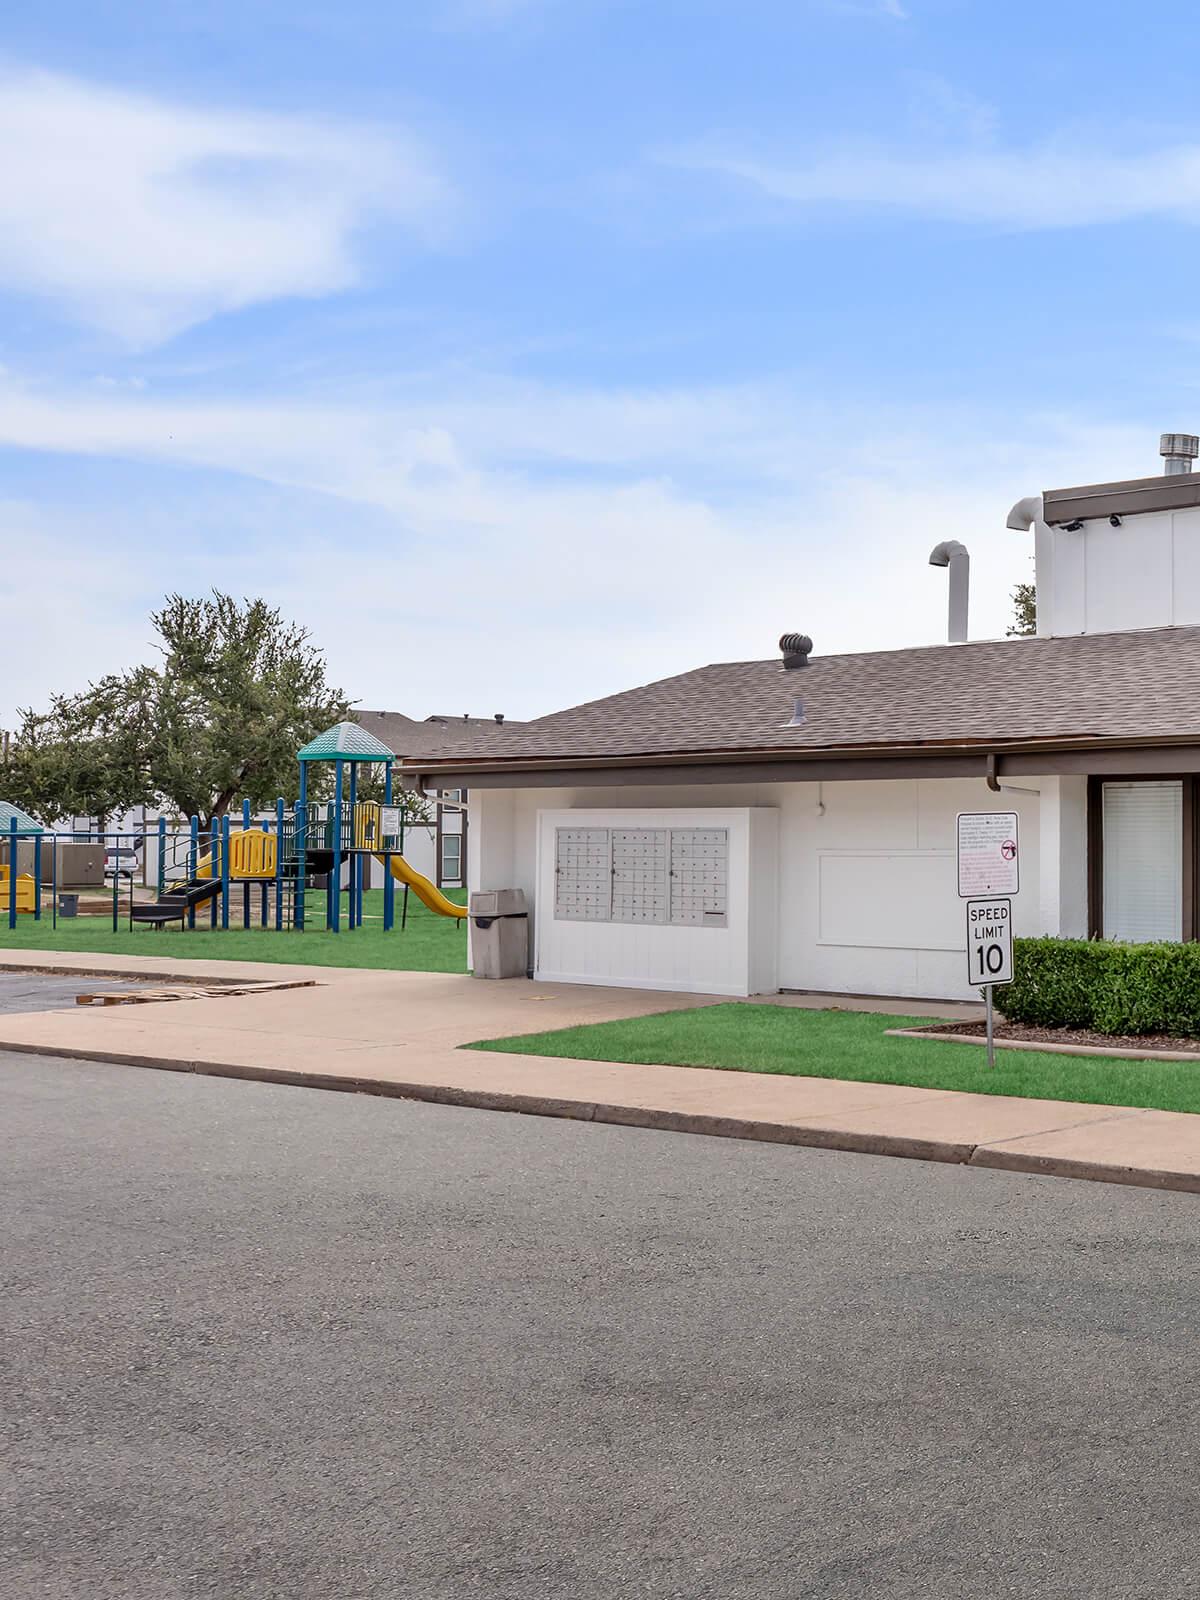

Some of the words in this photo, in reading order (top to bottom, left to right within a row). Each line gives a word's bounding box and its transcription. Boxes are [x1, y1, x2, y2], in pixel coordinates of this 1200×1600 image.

[970, 907, 1008, 922] SPEED
[974, 925, 1005, 939] LIMIT
[976, 943, 1004, 975] 10
